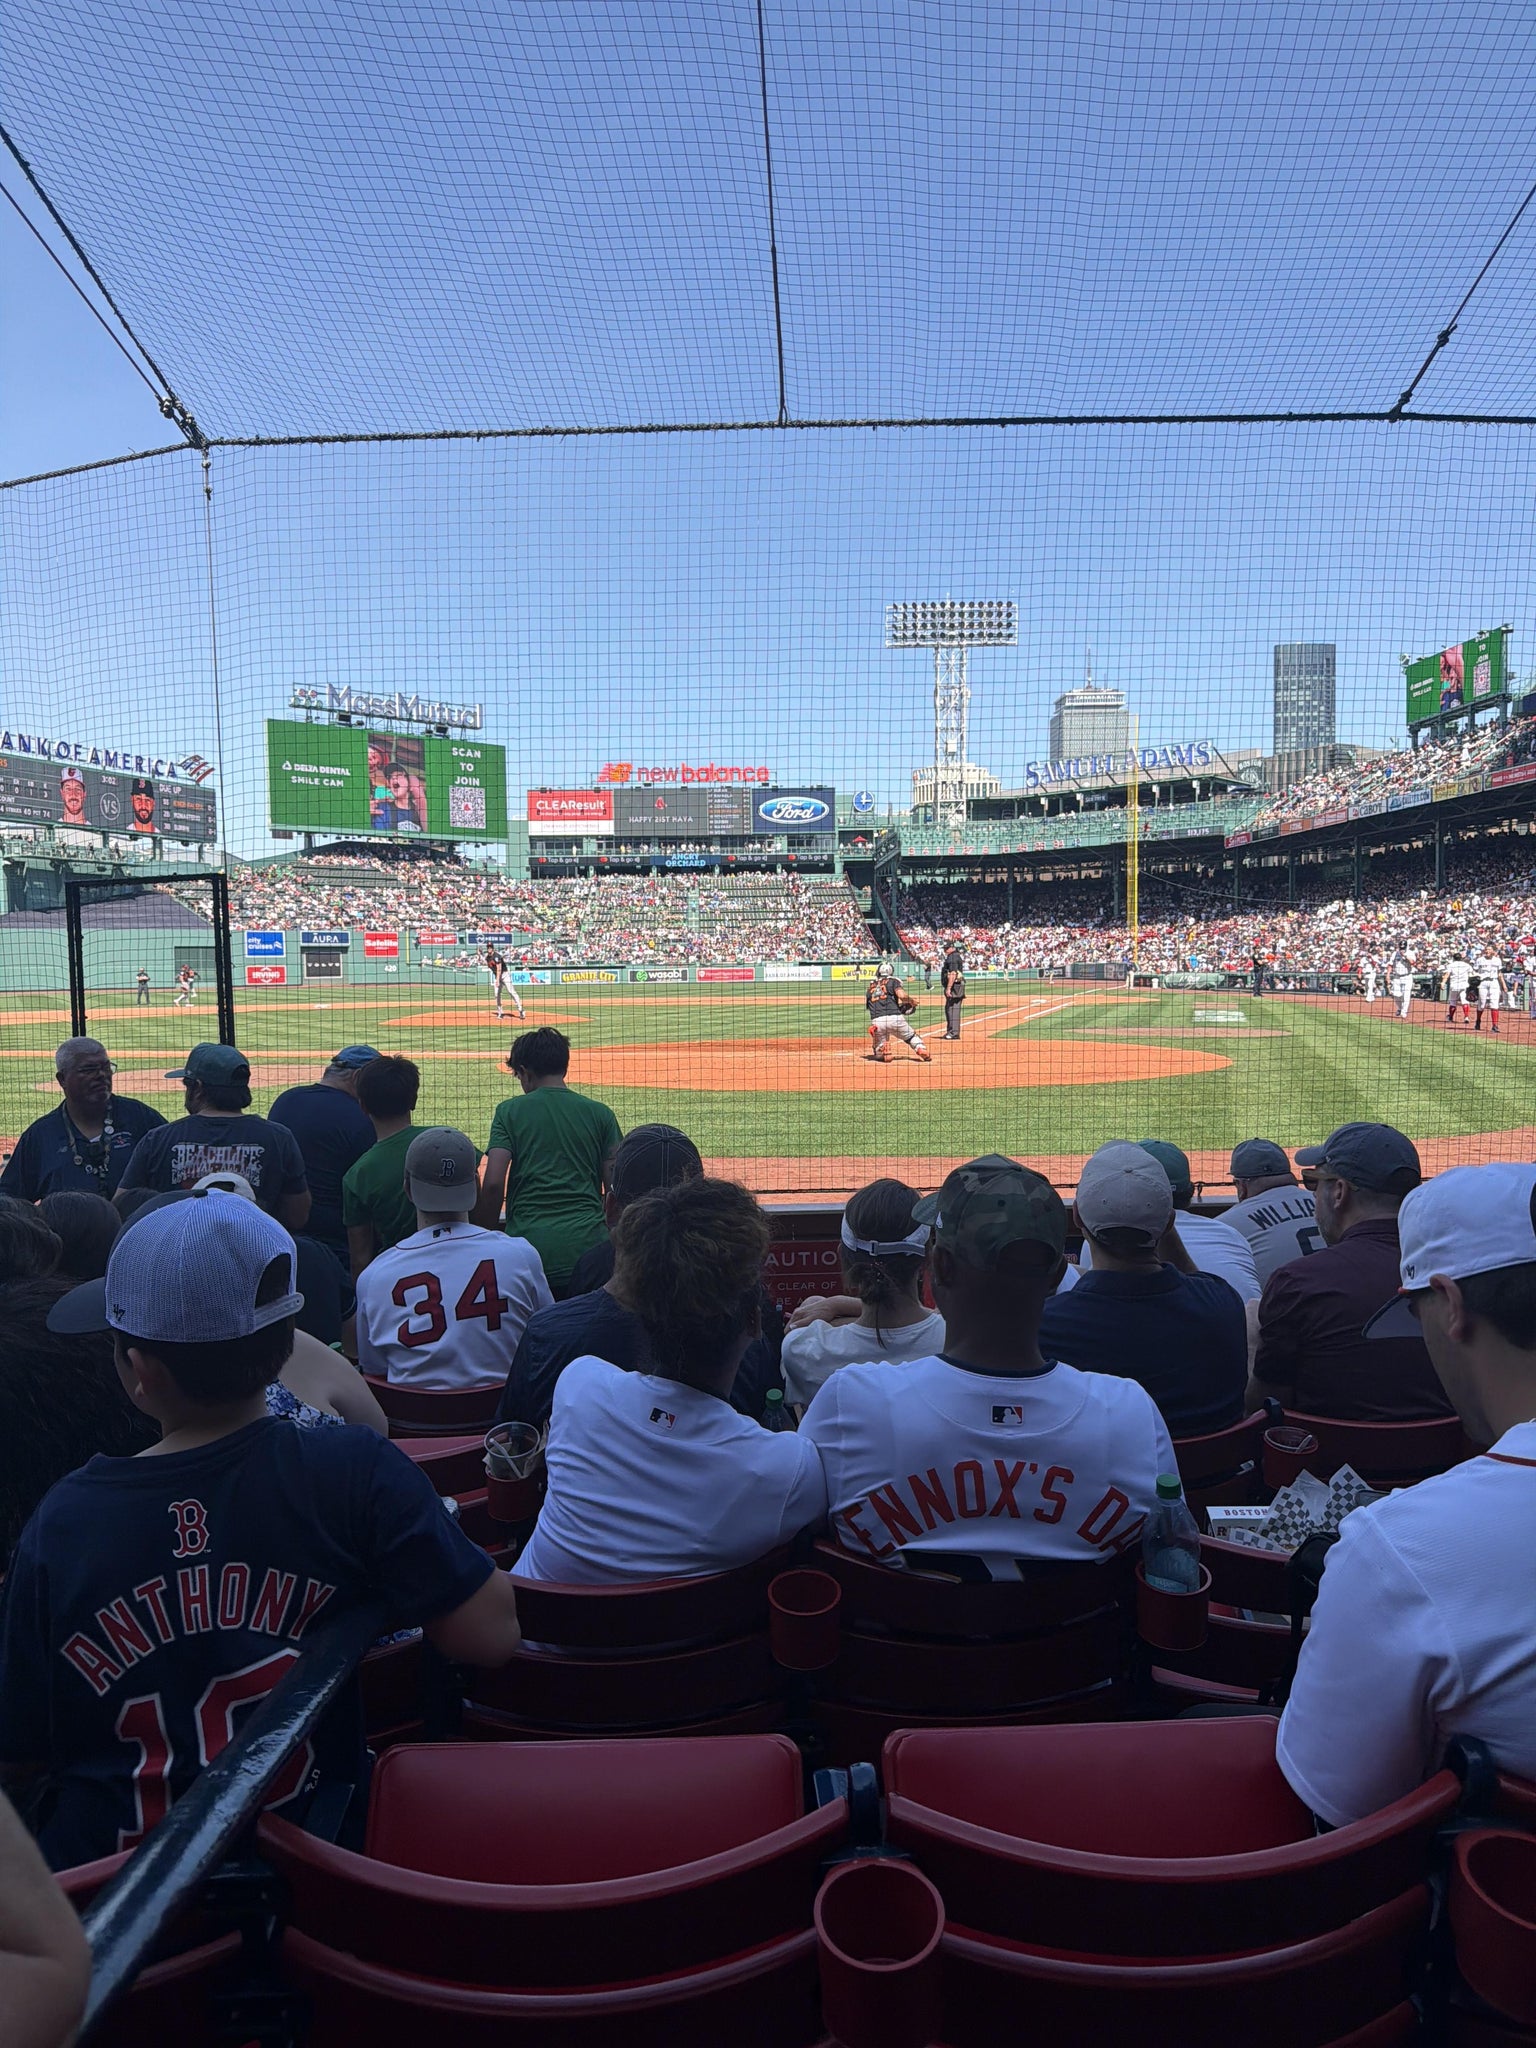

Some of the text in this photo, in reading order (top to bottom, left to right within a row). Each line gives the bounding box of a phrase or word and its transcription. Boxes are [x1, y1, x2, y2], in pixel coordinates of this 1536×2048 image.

[326, 683, 483, 730] MassMutual
[0, 730, 178, 778] ANK OF AMERICA
[452, 747, 481, 759] SCAN
[459, 762, 475, 772] TO
[1026, 741, 1213, 788] SAMUEL ADAMS
[291, 775, 344, 788] SMILE CAM
[454, 776, 480, 787] JOIN
[159, 783, 182, 795] DUE UP
[103, 799, 117, 815] VS
[536, 800, 605, 811] CLEAResult
[772, 800, 815, 819] Ford
[665, 859, 706, 867] ORCHARD
[247, 937, 261, 945] city
[252, 970, 281, 979] IRVING
[562, 971, 617, 981] GRANITE CITY
[649, 970, 682, 979] wasabi
[171, 1143, 265, 1169] BEACHLIFE
[439, 1157, 456, 1177] B
[1247, 1198, 1316, 1230] WILLIA
[763, 1250, 838, 1266] AUTIO
[777, 1281, 816, 1291] CLEAR
[821, 1281, 837, 1290] OF
[391, 1258, 509, 1348] 34
[840, 1459, 1075, 1557] ENNOX'S
[1223, 1509, 1268, 1517] BOSTON
[168, 1498, 210, 1559] B
[60, 1562, 337, 1696] ANTHONY
